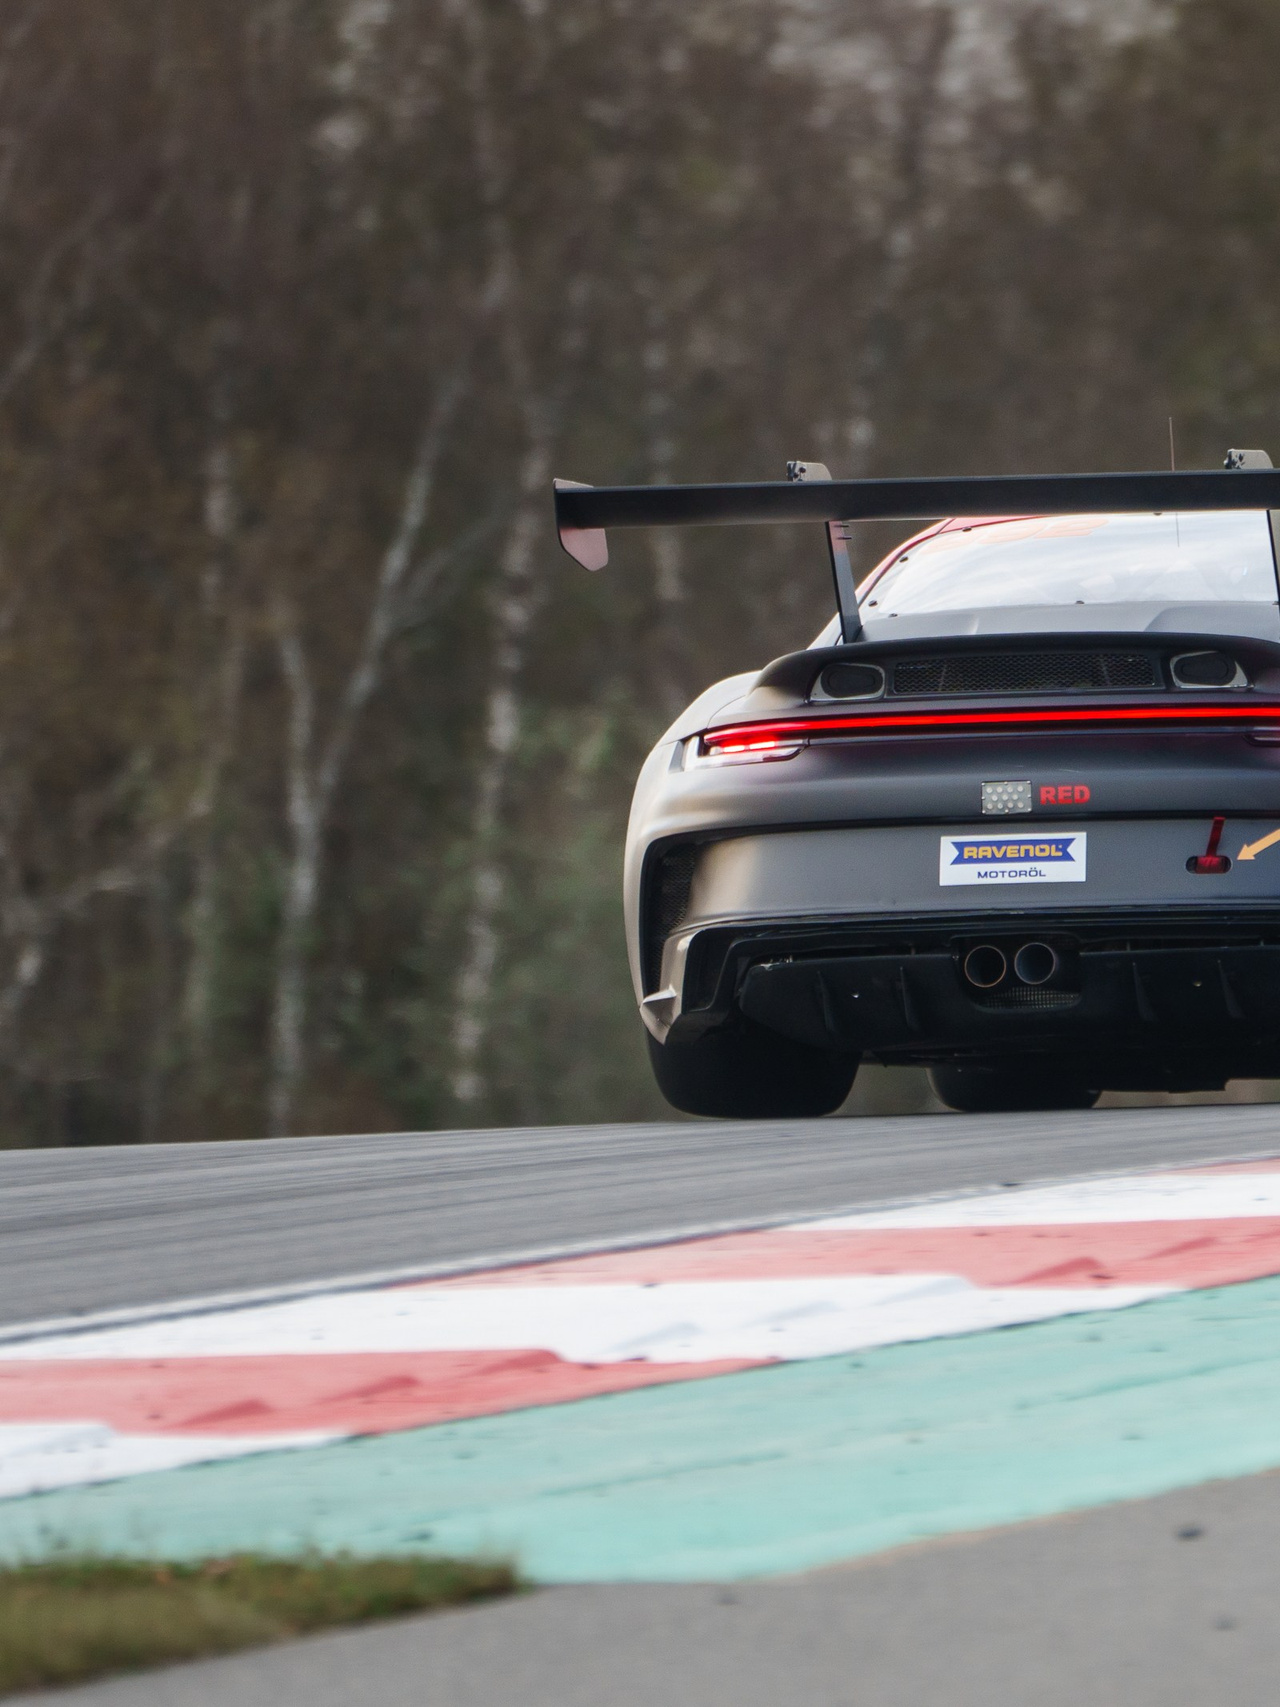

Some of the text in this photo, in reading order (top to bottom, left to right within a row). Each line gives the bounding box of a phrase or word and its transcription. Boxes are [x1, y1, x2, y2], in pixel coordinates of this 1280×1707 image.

[1040, 785, 1091, 805] RED
[963, 844, 1063, 859] RAVENOL
[977, 867, 1047, 879] MOTORÖL
